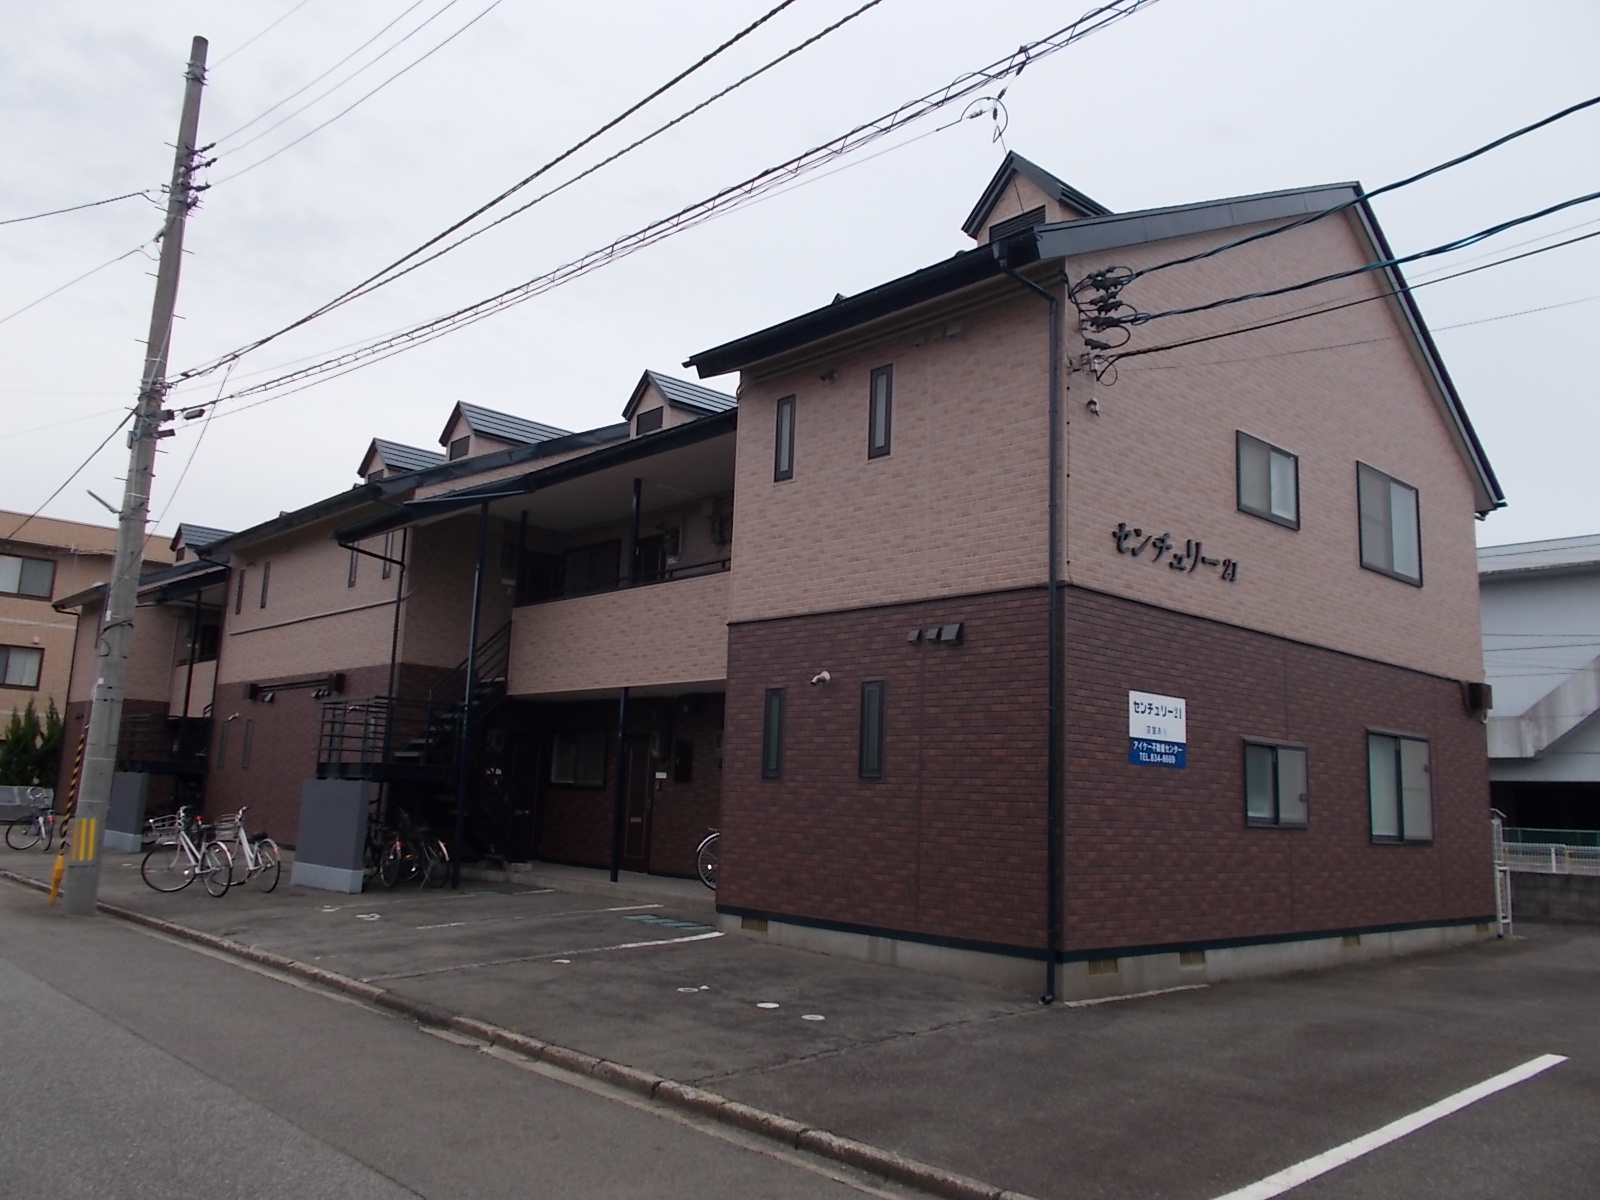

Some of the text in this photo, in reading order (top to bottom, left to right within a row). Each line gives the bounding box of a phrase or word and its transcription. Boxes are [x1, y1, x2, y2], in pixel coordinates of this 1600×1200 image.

[1133, 701, 1182, 719] センチュリー21
